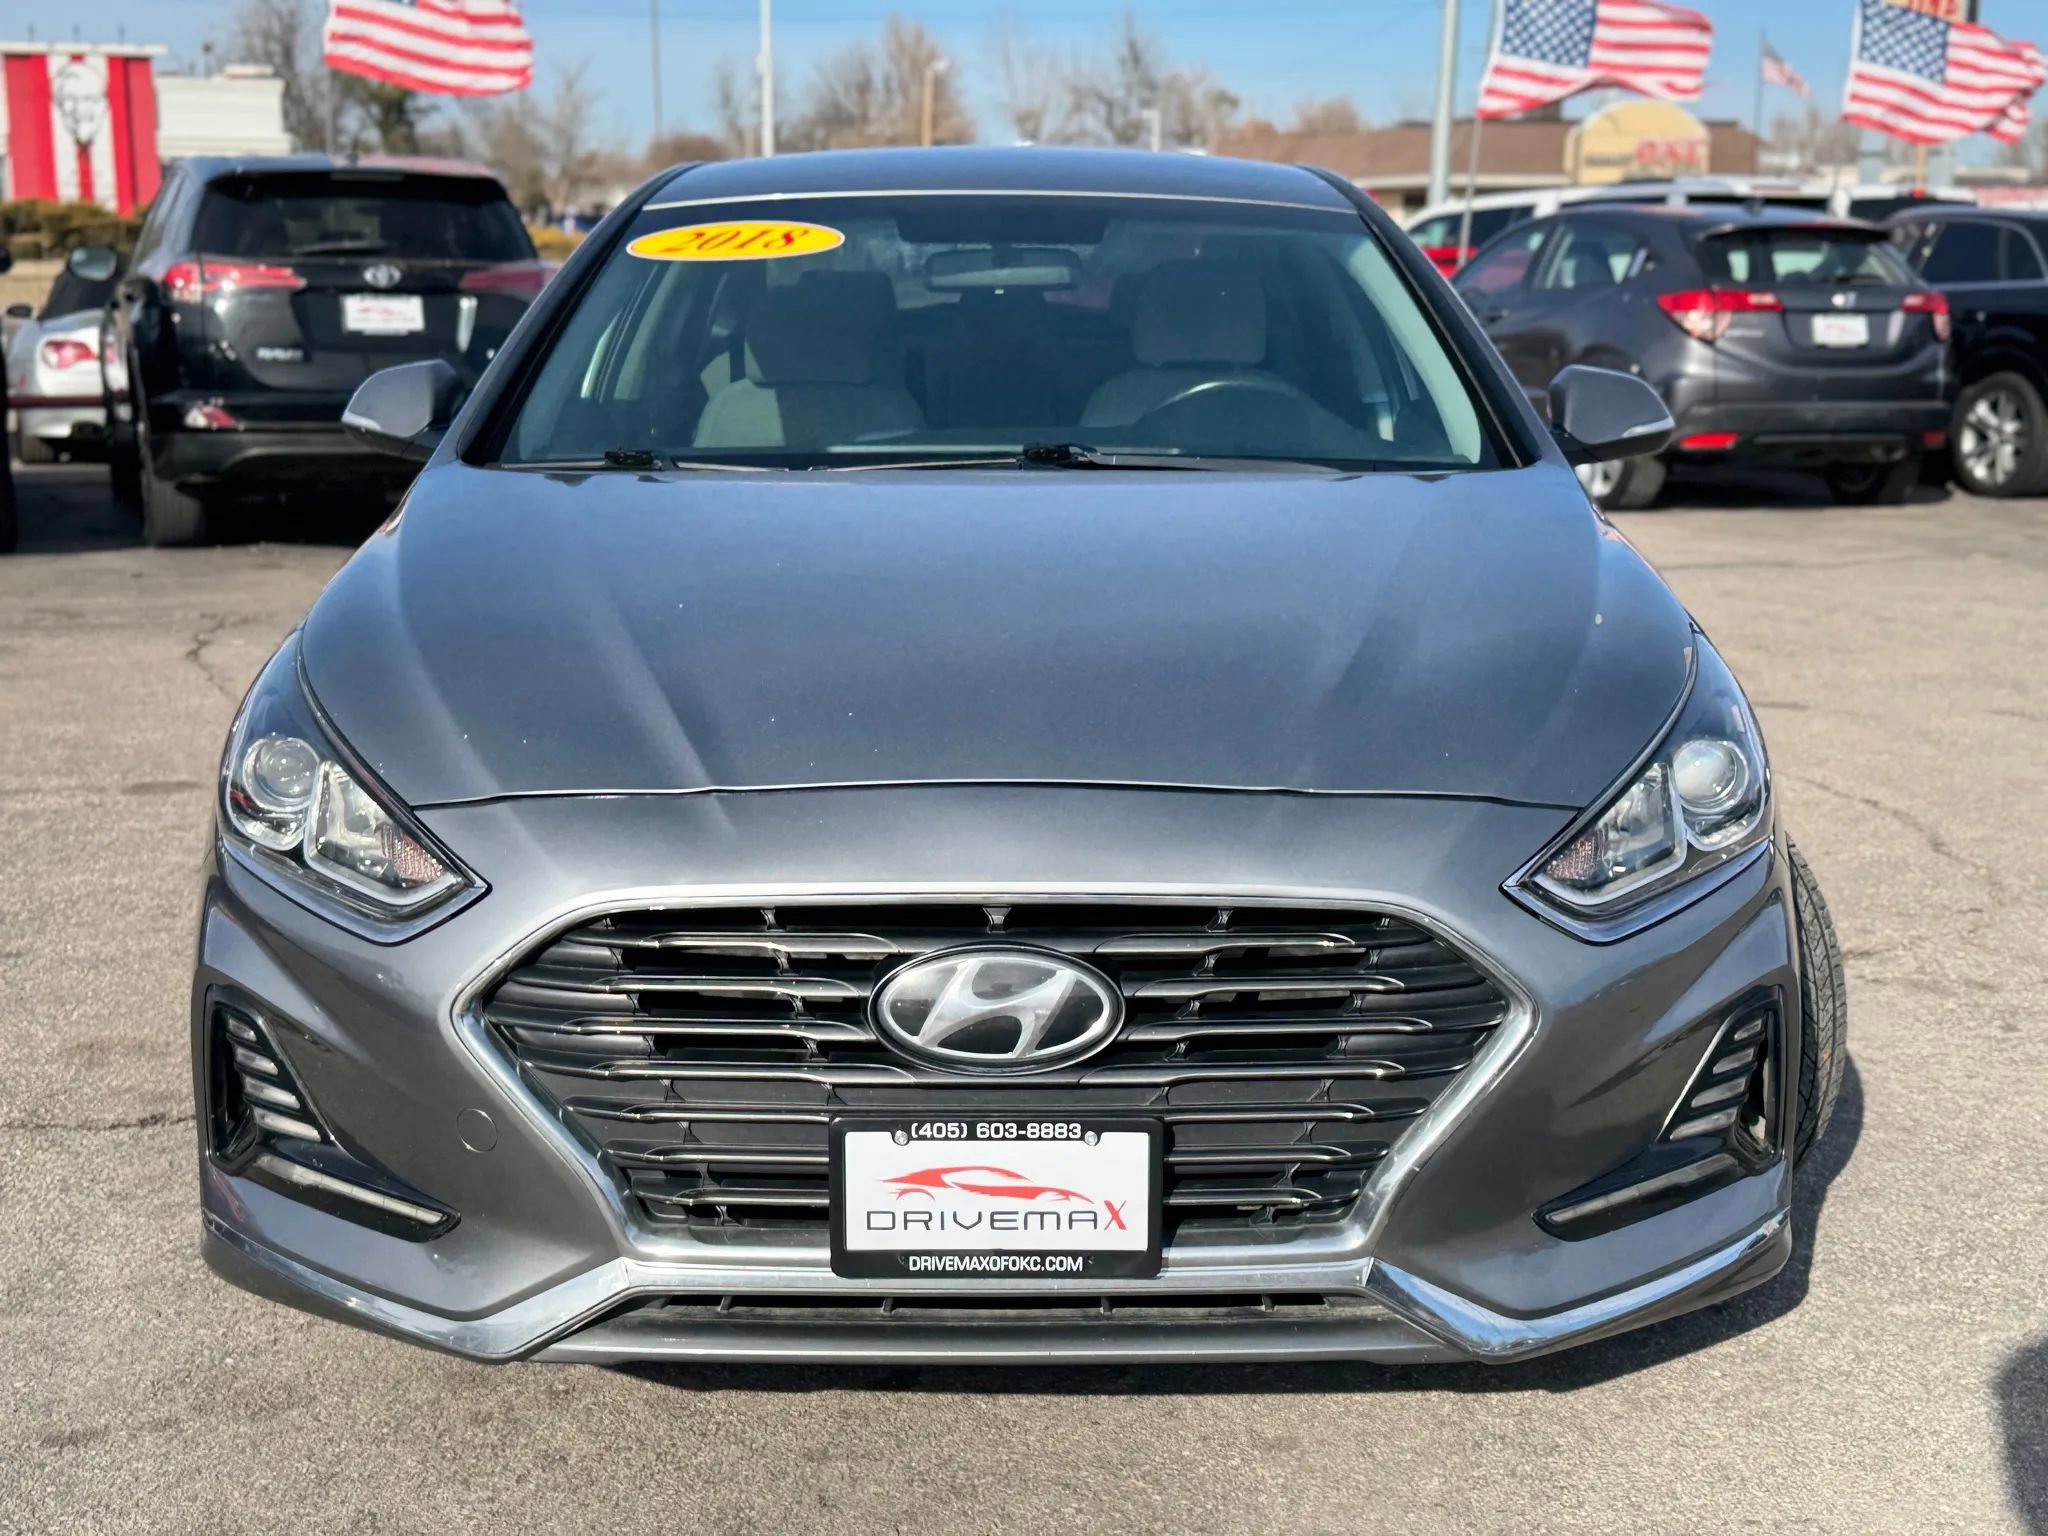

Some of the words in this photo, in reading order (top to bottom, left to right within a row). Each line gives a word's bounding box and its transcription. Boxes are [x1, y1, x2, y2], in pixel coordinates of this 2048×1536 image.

[656, 229, 810, 252] 2018
[911, 1122, 968, 1139] (405)
[976, 1122, 1082, 1139] 603-8883
[866, 1199, 1127, 1231] DRIVEMAX
[908, 1255, 1083, 1271] DRIVEMAXOFOKC.COM
